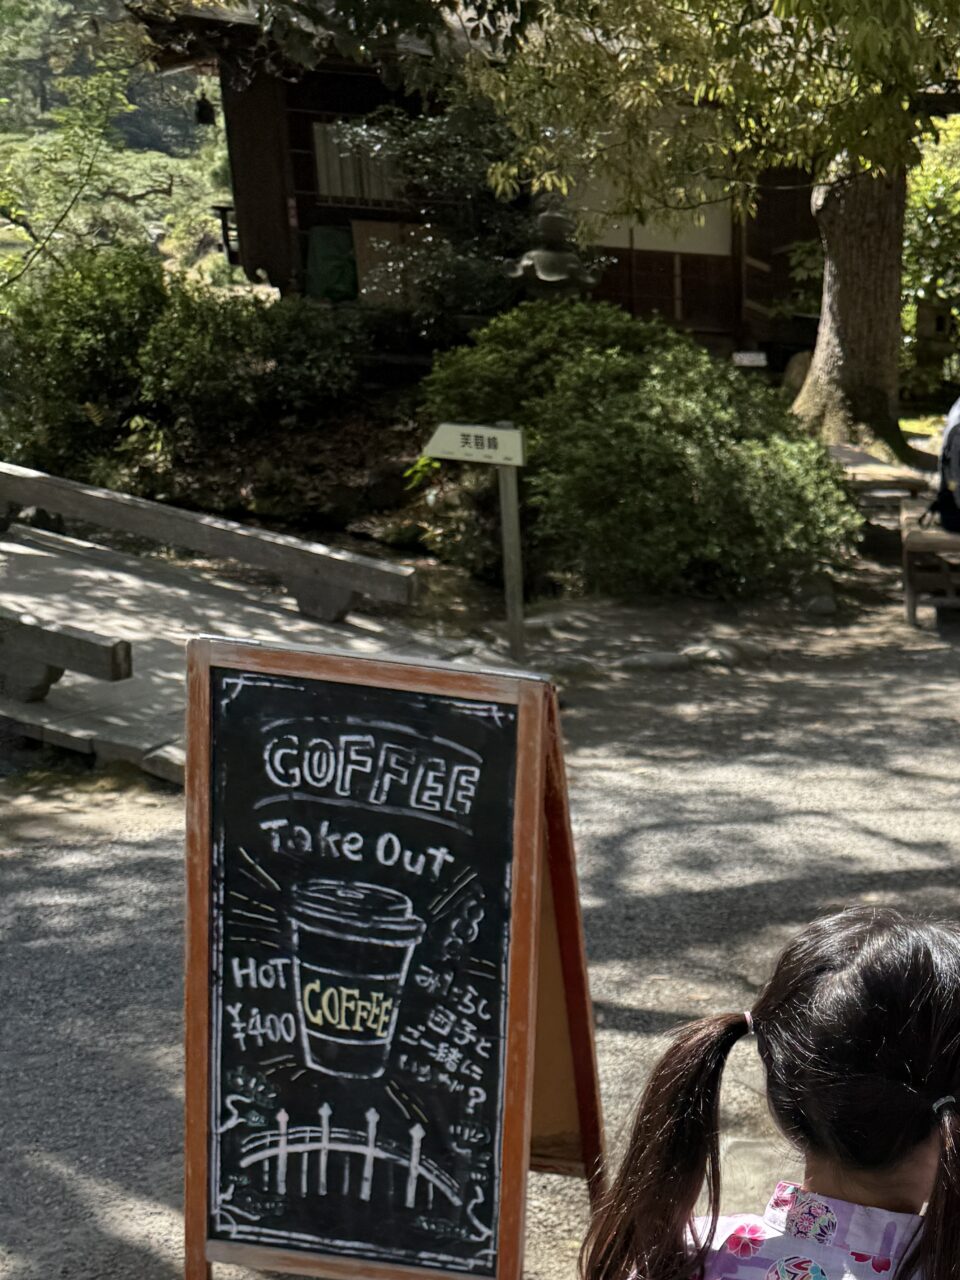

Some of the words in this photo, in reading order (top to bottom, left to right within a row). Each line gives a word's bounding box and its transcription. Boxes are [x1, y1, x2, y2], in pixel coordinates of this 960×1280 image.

[263, 734, 481, 815] COFFEE
[259, 818, 364, 862] Take
[375, 831, 456, 878] Out
[302, 979, 393, 1038] COFFEE
[414, 963, 492, 1021] みたらし
[226, 1001, 297, 1051] ¥400
[400, 1024, 484, 1081] ご一緒に
[426, 1004, 492, 1059] 団子と
